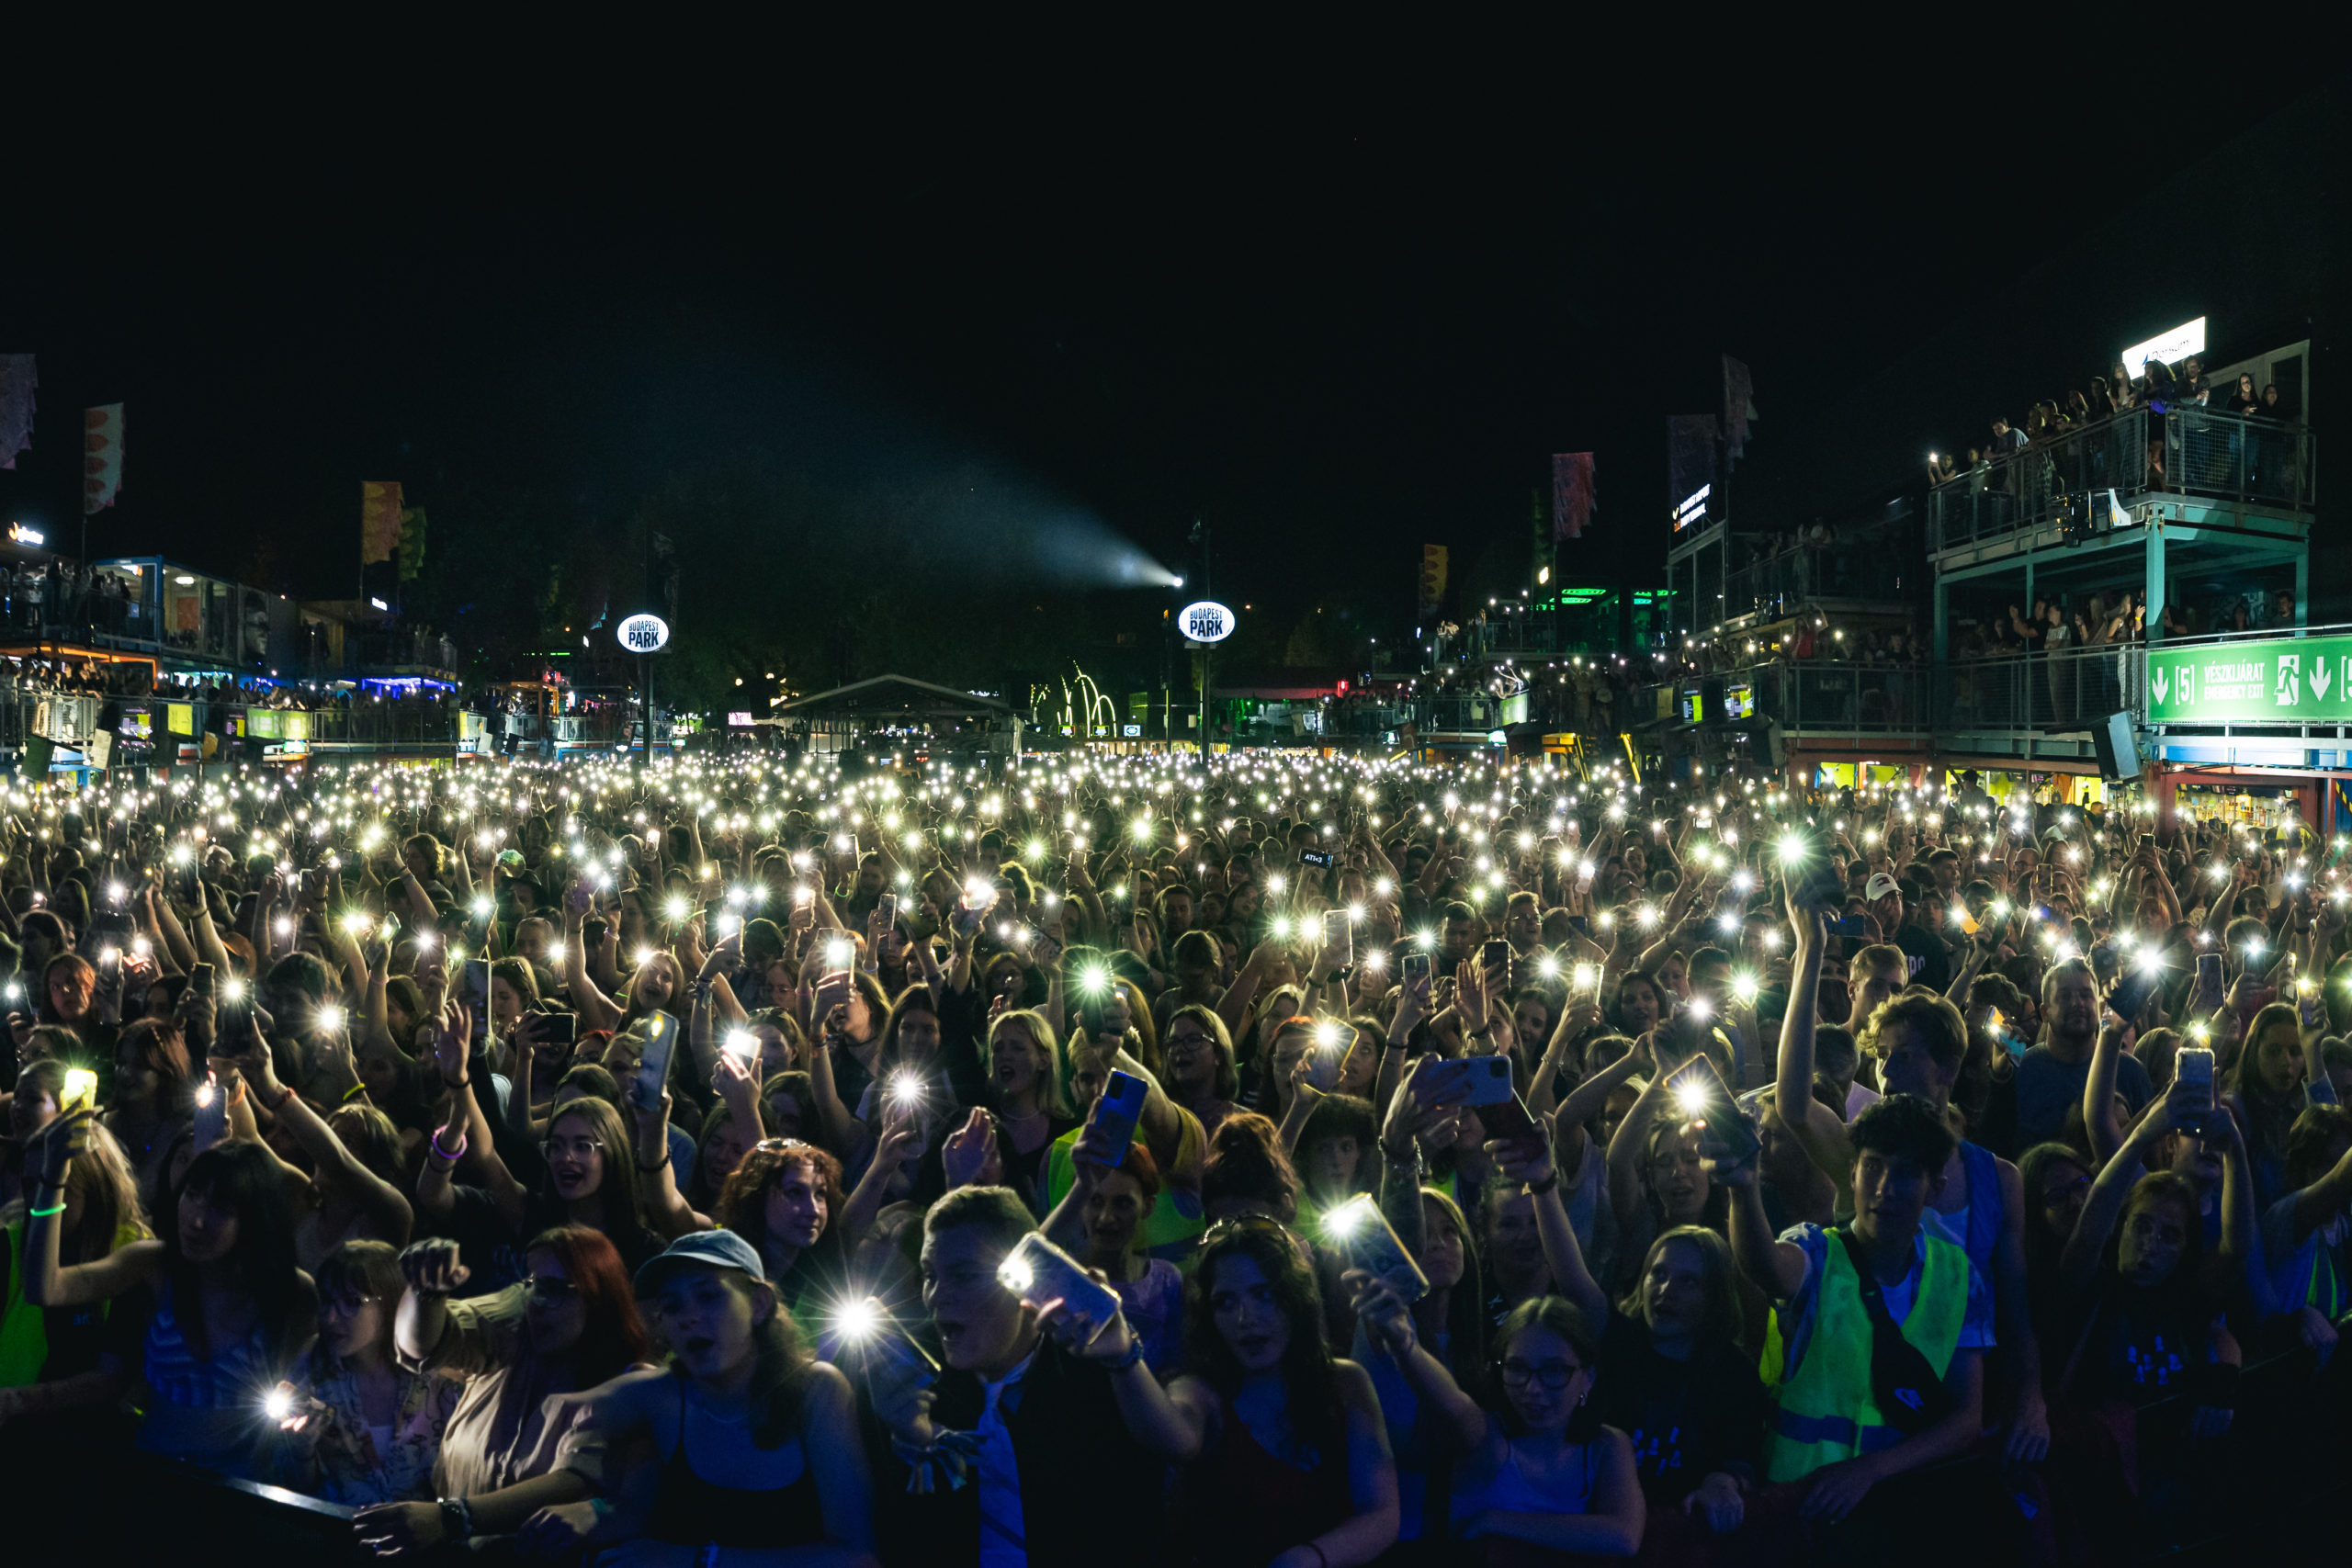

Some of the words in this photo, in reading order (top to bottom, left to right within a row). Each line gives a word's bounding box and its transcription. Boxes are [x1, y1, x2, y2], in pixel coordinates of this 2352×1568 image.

[1190, 607, 1223, 619] BUDAPEST
[628, 620, 659, 631] BUDAPEST
[1190, 620, 1223, 637] PARK
[628, 632, 659, 648] PARK
[2205, 658, 2265, 683] VÉSZKIJÁRAT
[2247, 683, 2265, 698] EXIT
